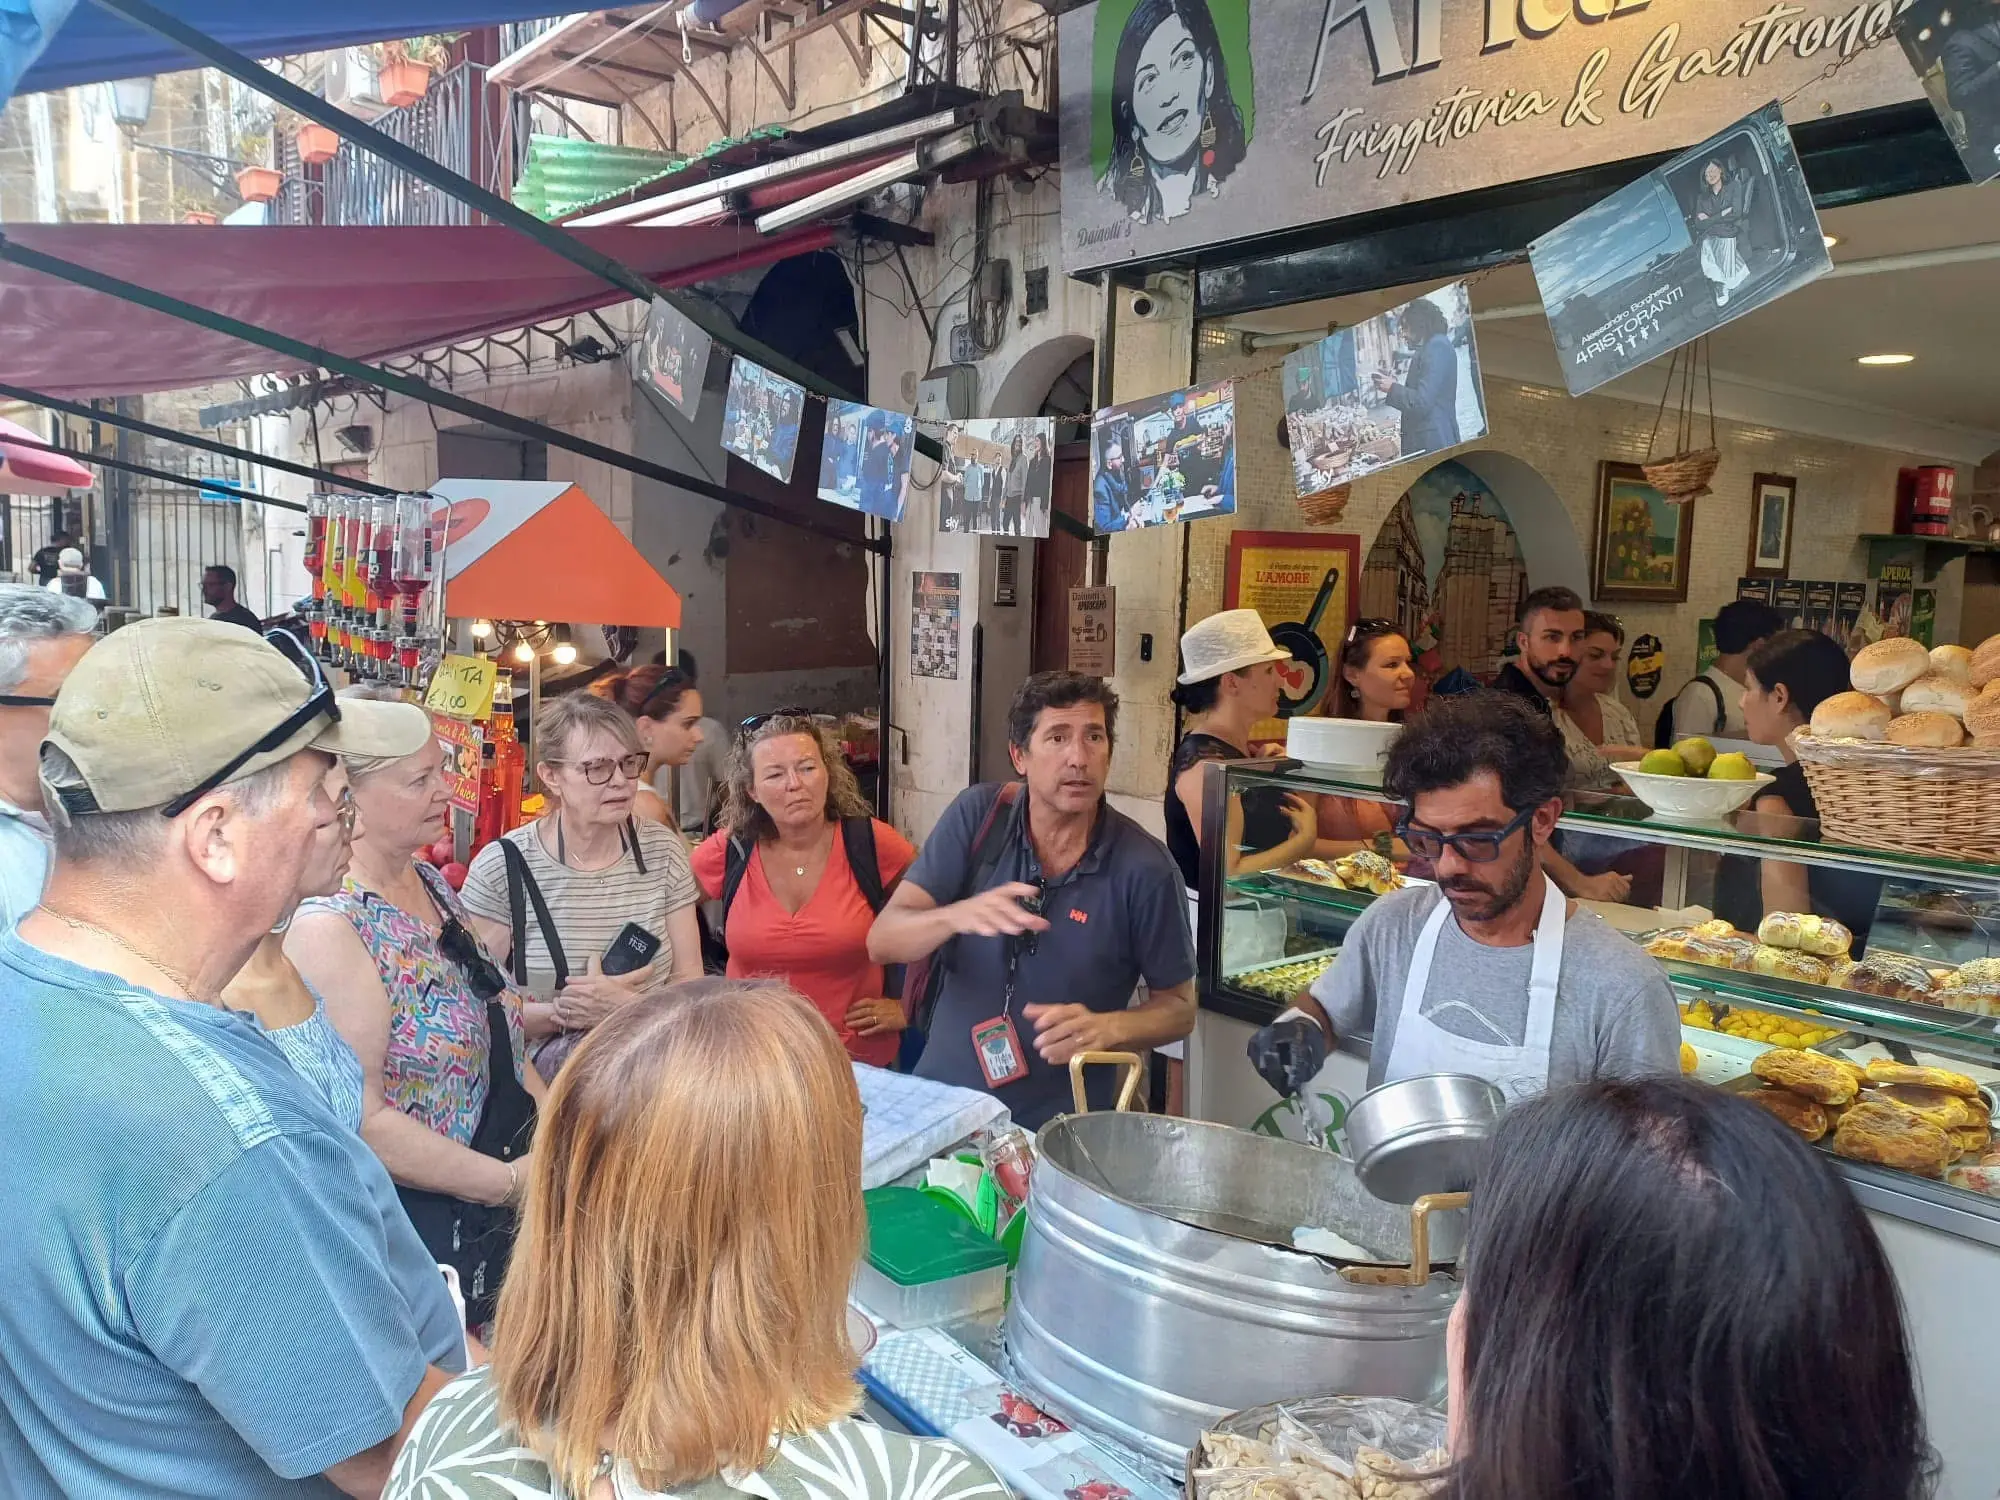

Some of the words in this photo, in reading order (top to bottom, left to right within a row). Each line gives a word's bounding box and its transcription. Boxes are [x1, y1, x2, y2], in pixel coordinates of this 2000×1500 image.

[1315, 86, 1558, 187] Friggitoria
[1561, 48, 1610, 127] &
[1617, 0, 1912, 118] Gastrono
[1581, 310, 1630, 345] Alessandro
[1630, 283, 1670, 313] Borghese
[945, 516, 960, 532] sky
